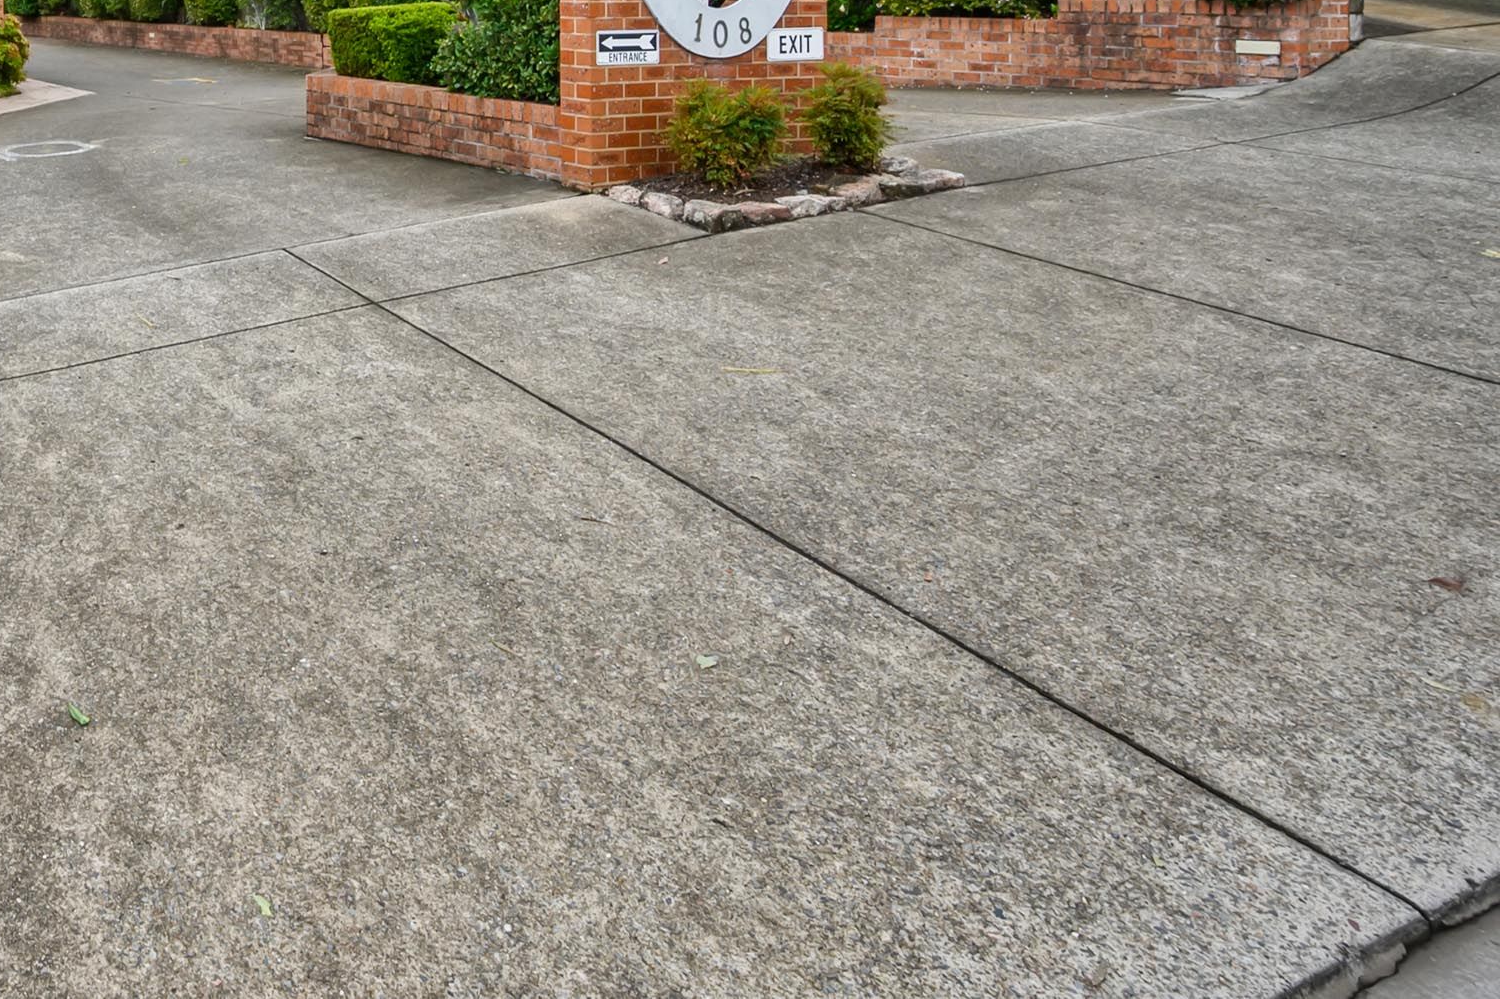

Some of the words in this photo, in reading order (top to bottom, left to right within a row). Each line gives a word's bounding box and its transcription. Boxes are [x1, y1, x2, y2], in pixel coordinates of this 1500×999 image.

[694, 13, 752, 48] 108
[779, 34, 813, 55] EXIT
[608, 51, 648, 63] ENTRANCE
